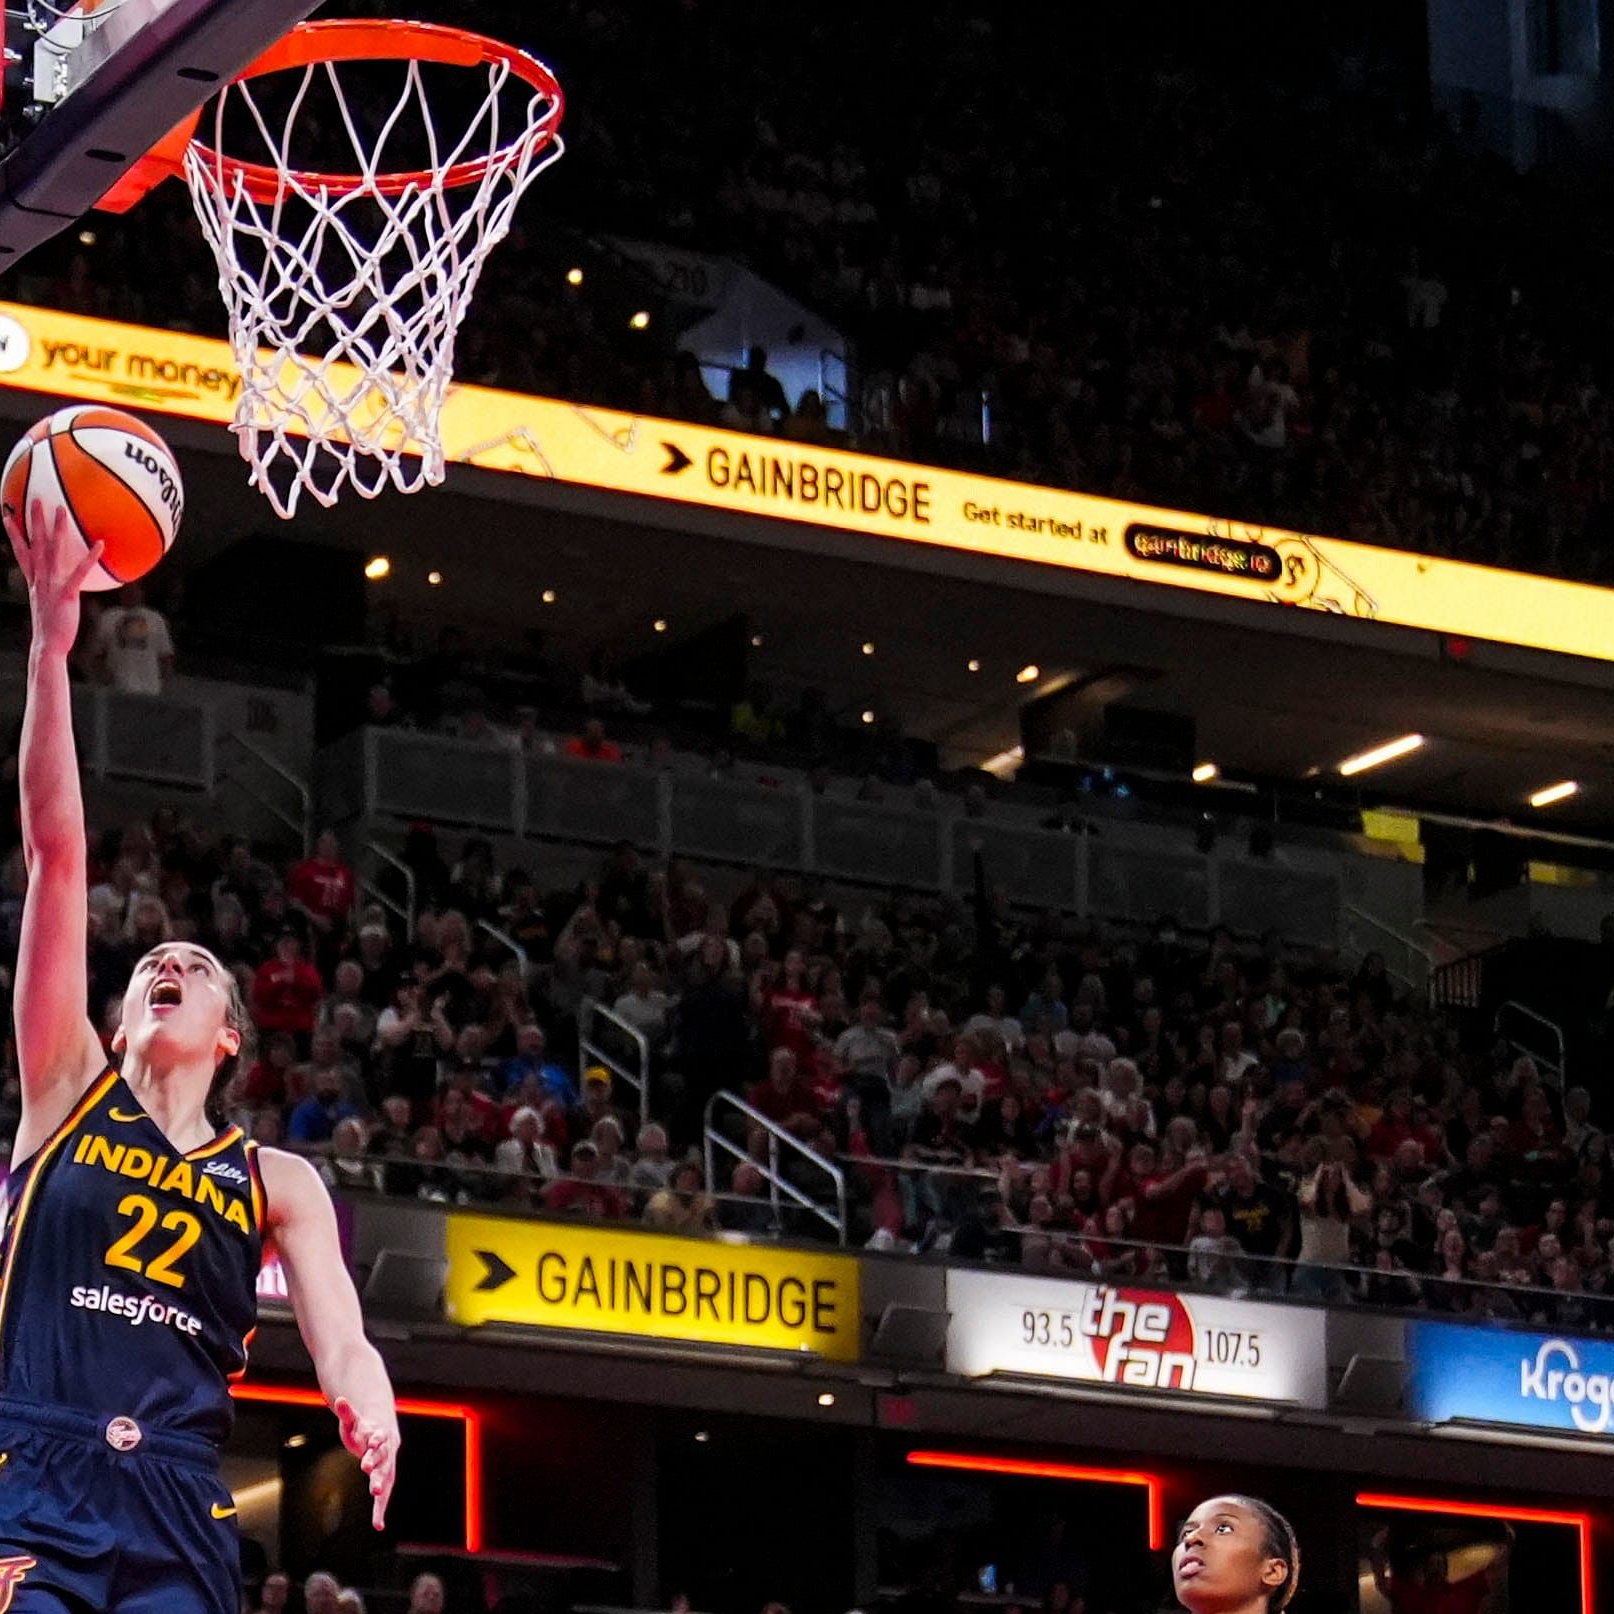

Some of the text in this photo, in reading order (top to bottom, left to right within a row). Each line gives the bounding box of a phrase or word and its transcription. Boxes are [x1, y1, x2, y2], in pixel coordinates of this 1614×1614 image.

[41, 334, 118, 372] your
[706, 446, 932, 525] GAINBRIDGE
[962, 500, 1108, 545] Get started at
[73, 1134, 251, 1235] INDIANA
[201, 1160, 248, 1185] Lilly
[104, 1193, 204, 1289] 22
[70, 1285, 203, 1338] salesforce
[534, 1251, 839, 1335] GAINBRIDGE
[1080, 1284, 1171, 1343] the
[1022, 1310, 1075, 1348] 93.5
[1204, 1329, 1262, 1369] 107.5
[1101, 1331, 1197, 1391] fan
